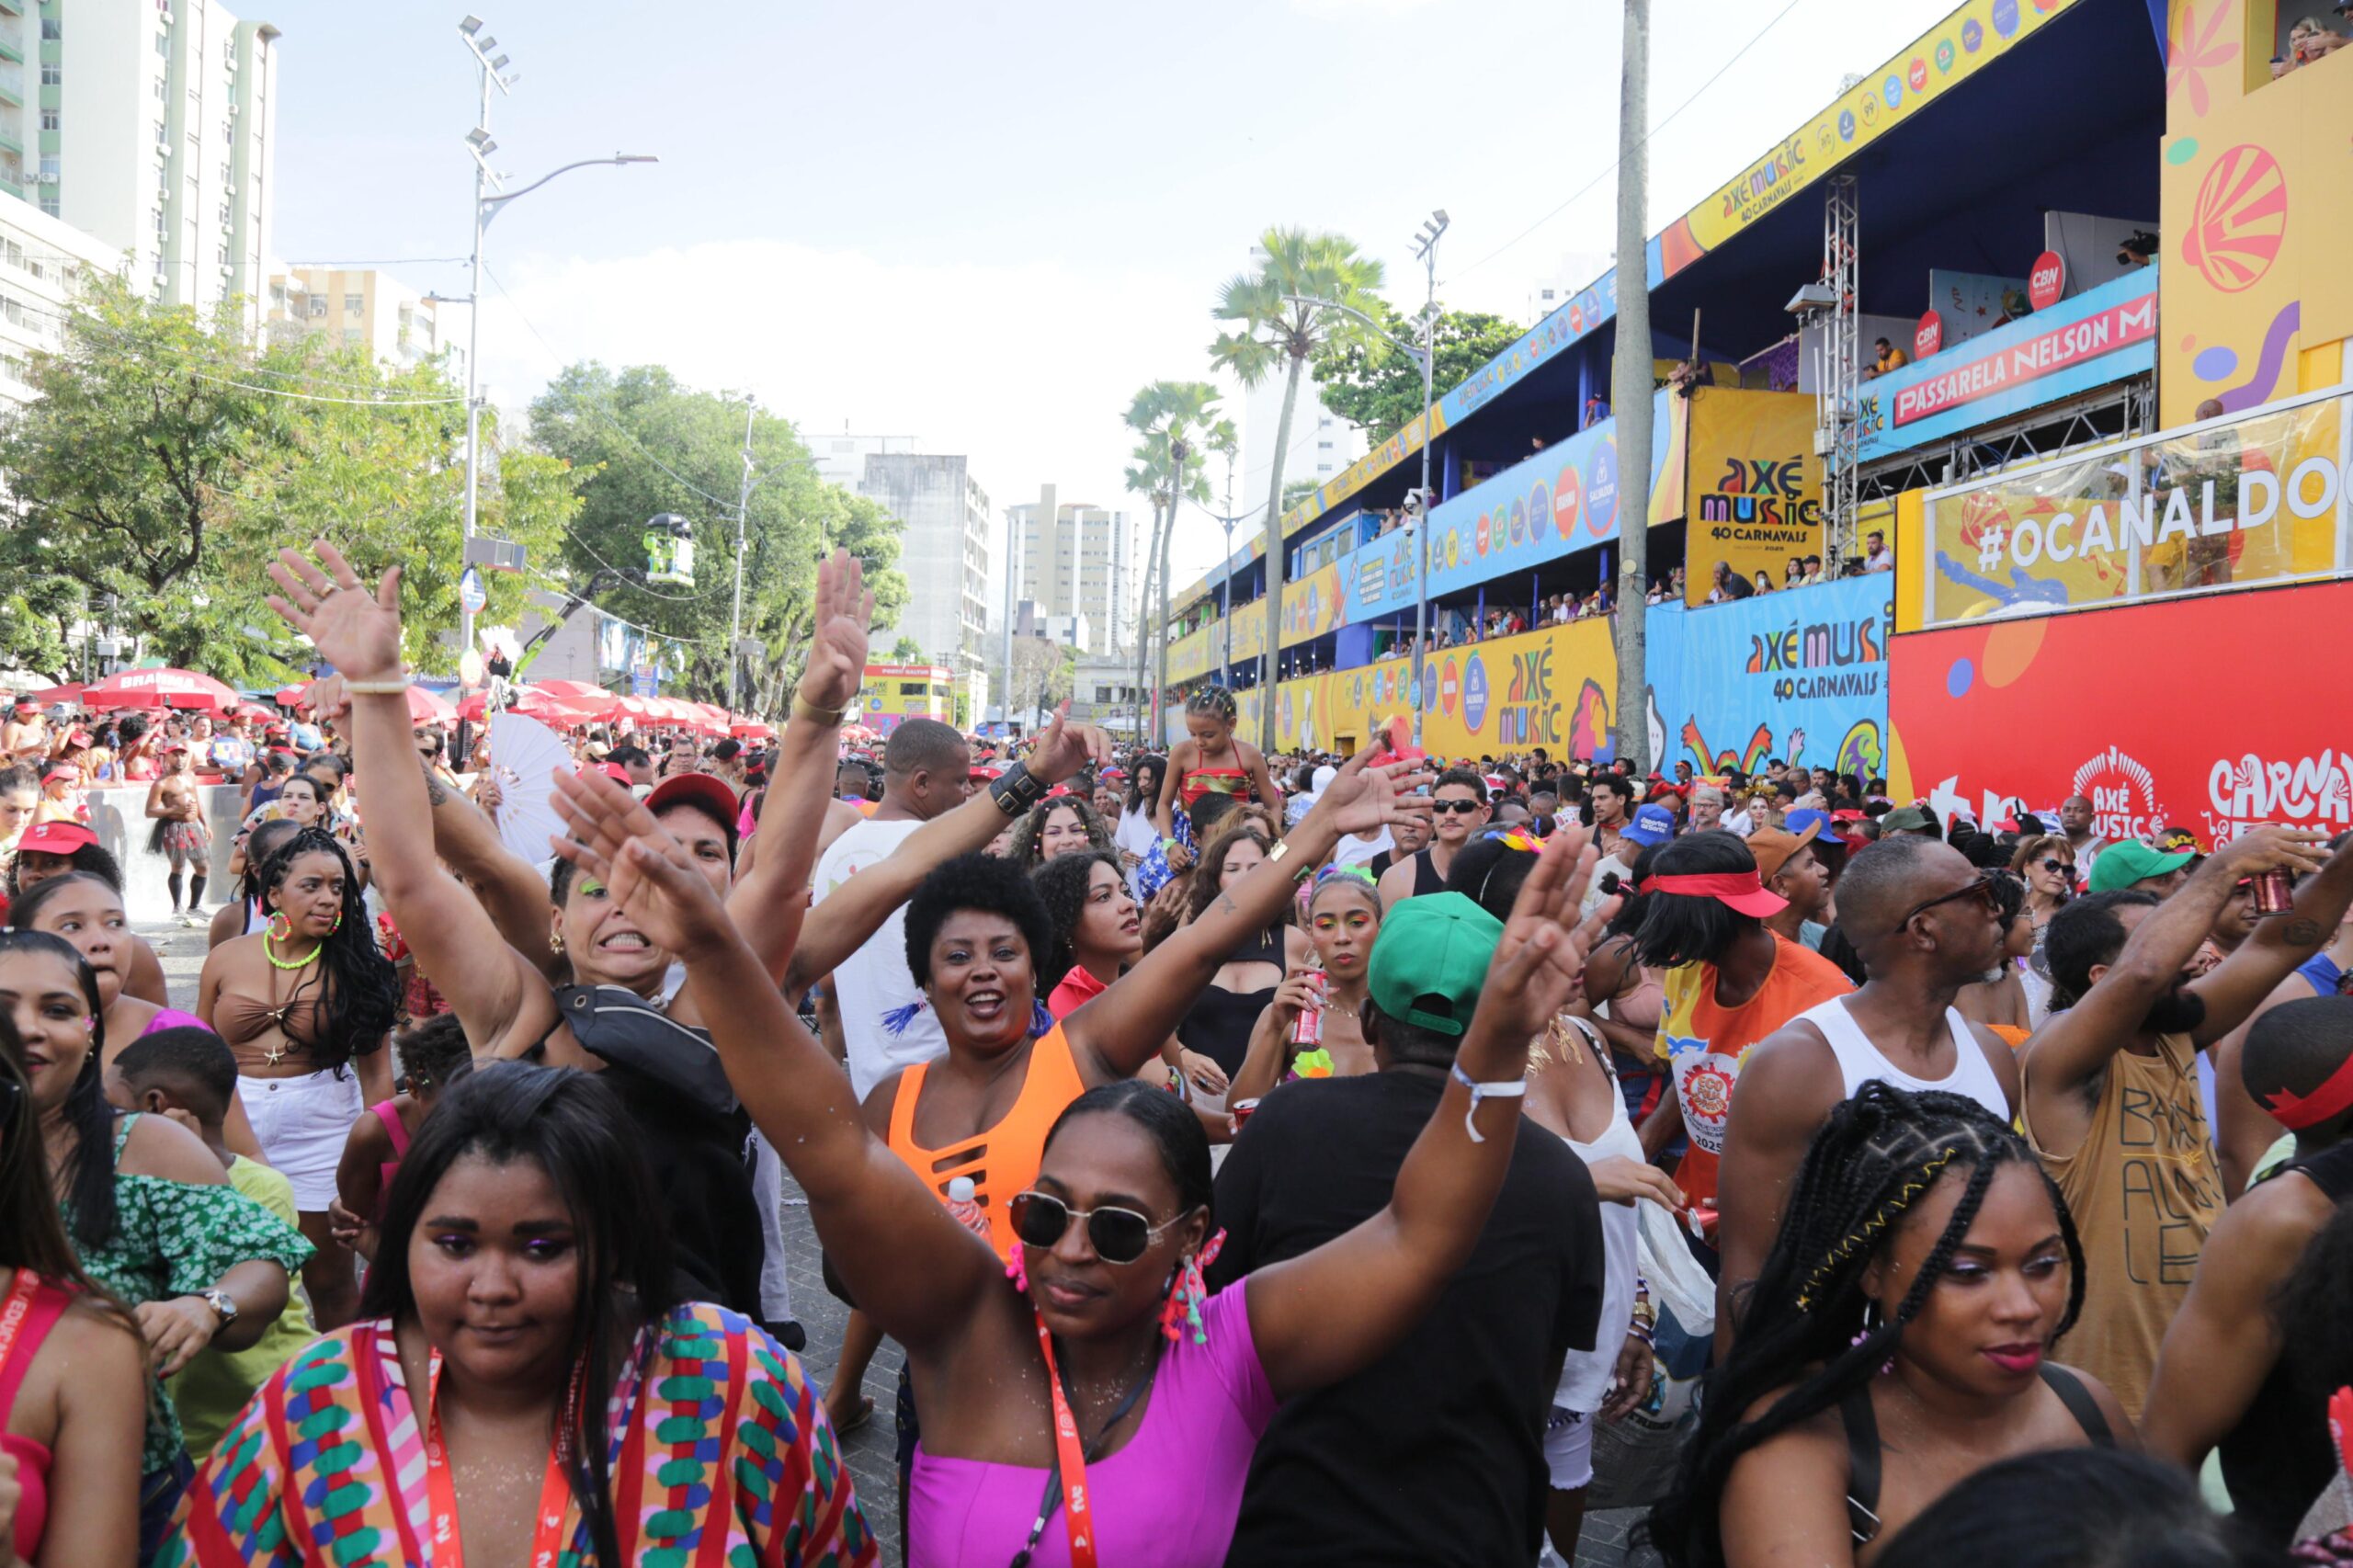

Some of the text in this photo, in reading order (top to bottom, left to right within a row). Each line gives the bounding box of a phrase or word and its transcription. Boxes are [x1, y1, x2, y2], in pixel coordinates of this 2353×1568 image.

[2032, 267, 2059, 289] CBN
[1916, 321, 1938, 347] CBN
[1899, 299, 2156, 418] PASSARELA NELSON M
[1711, 526, 1808, 543] 40 CARNAVAIS
[1773, 671, 1878, 702] 40 CARNAVAIS
[2093, 781, 2130, 813] AXÉ
[2090, 814, 2145, 839] USIC
[1698, 1074, 1724, 1092] ECO
[1696, 1134, 1722, 1153] 2025
